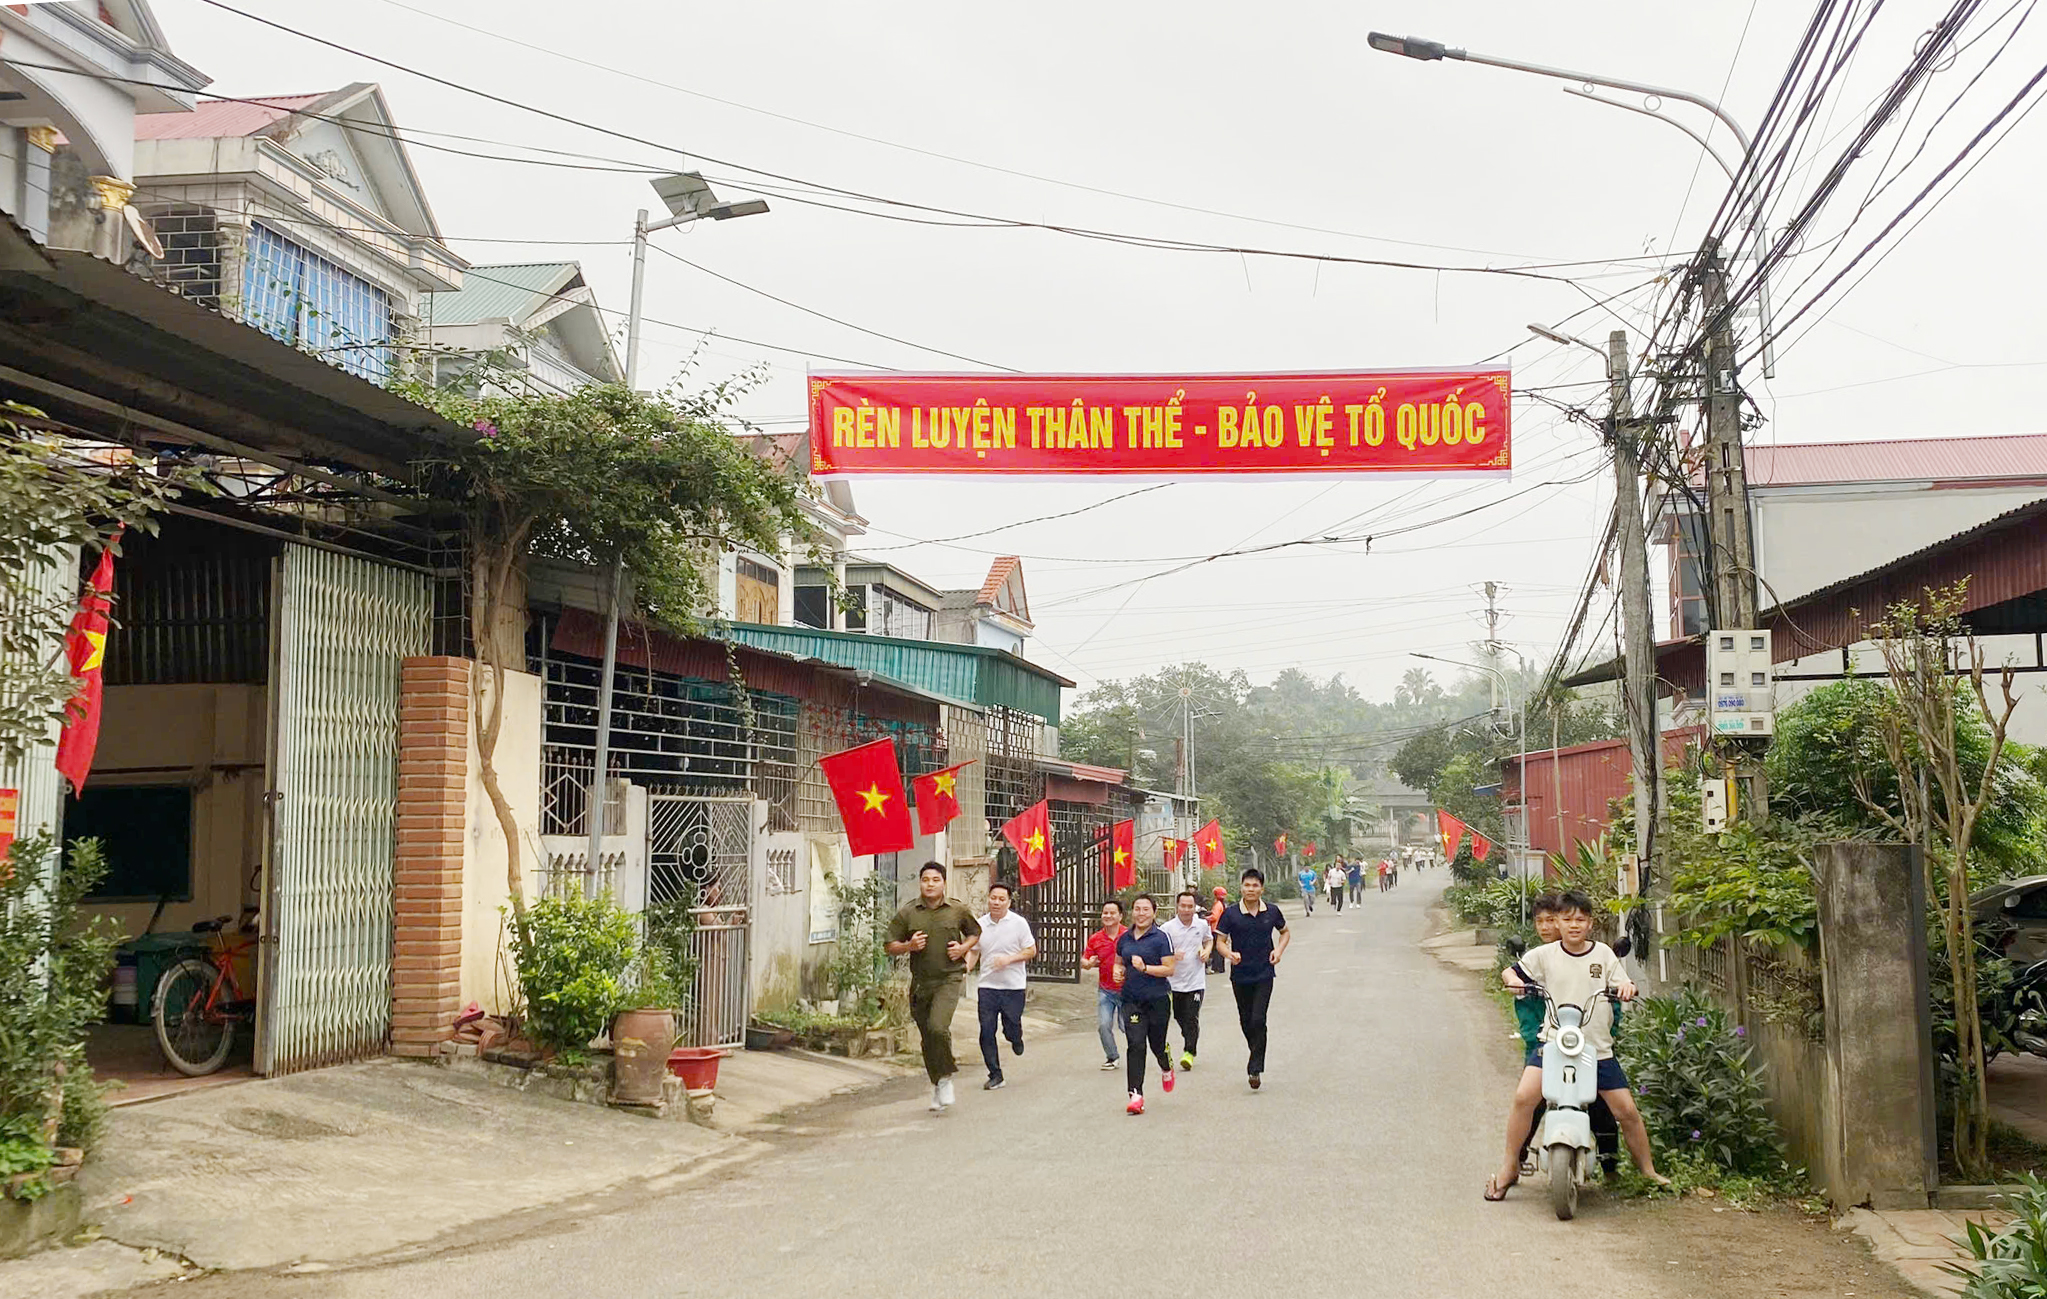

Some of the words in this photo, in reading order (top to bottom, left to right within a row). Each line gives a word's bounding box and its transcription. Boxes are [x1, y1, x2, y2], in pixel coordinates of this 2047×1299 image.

[832, 397, 901, 448] RÈN
[911, 397, 1016, 459] LUYỆN
[1026, 397, 1113, 449] THÂN
[1124, 388, 1186, 448] THỂ
[1194, 425, 1207, 435] -
[1218, 391, 1284, 448] BẢO
[1294, 395, 1335, 457] VỆ
[1345, 387, 1387, 447] TỔ
[1396, 387, 1486, 451] QUỐC
